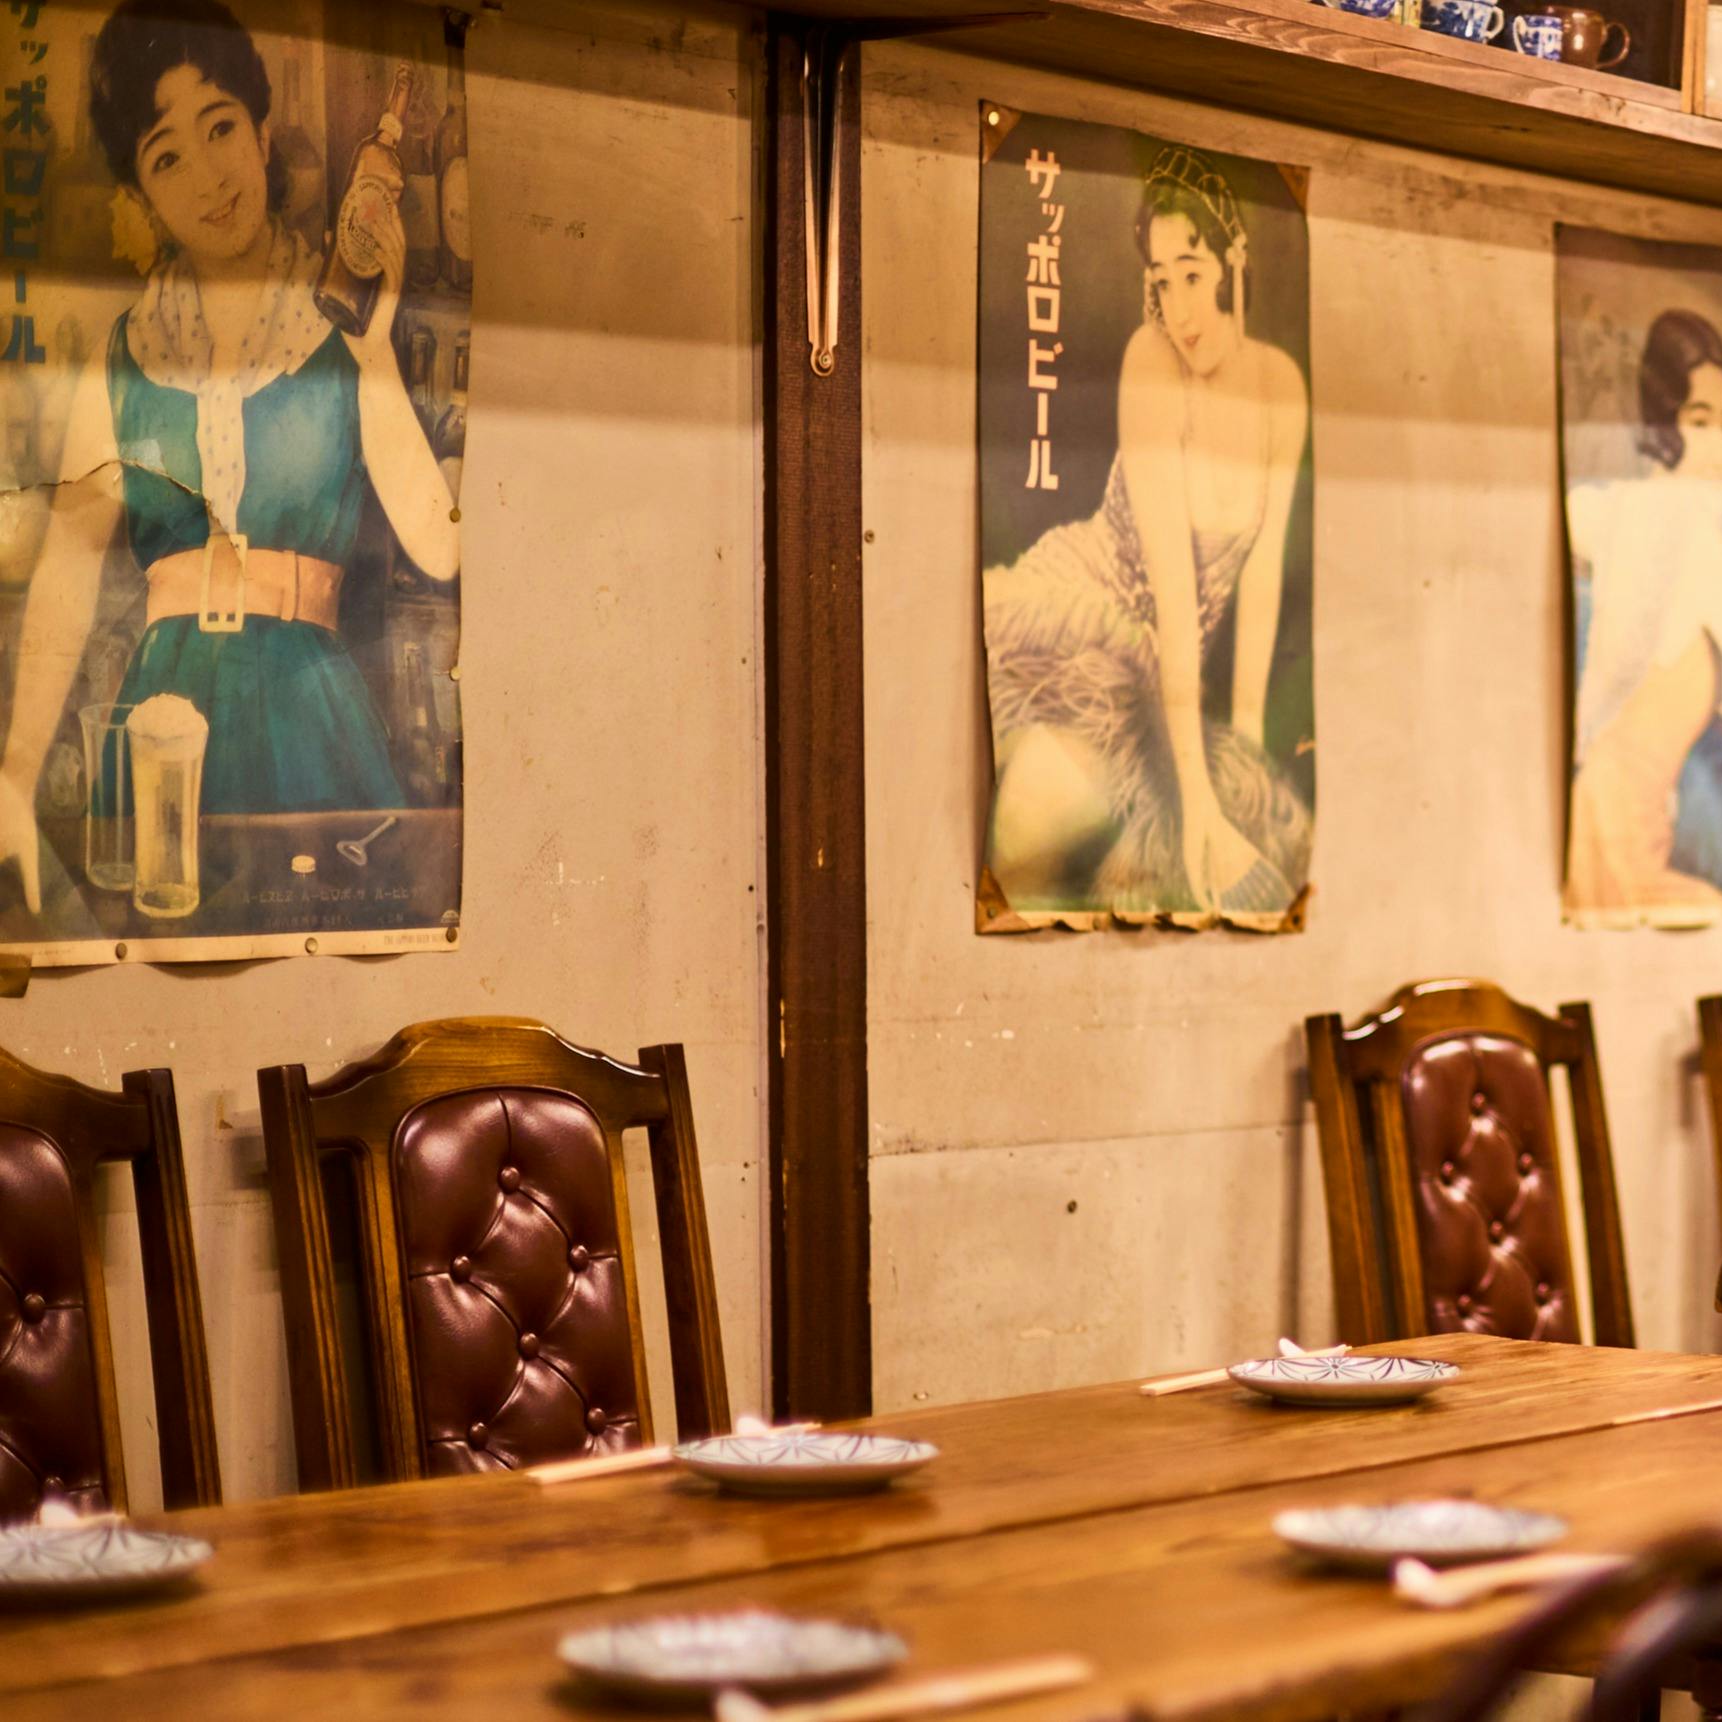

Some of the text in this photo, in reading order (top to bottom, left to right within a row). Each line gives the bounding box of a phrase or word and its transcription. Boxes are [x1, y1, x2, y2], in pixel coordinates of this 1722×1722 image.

[1024, 147, 1066, 491] サッポロビール
